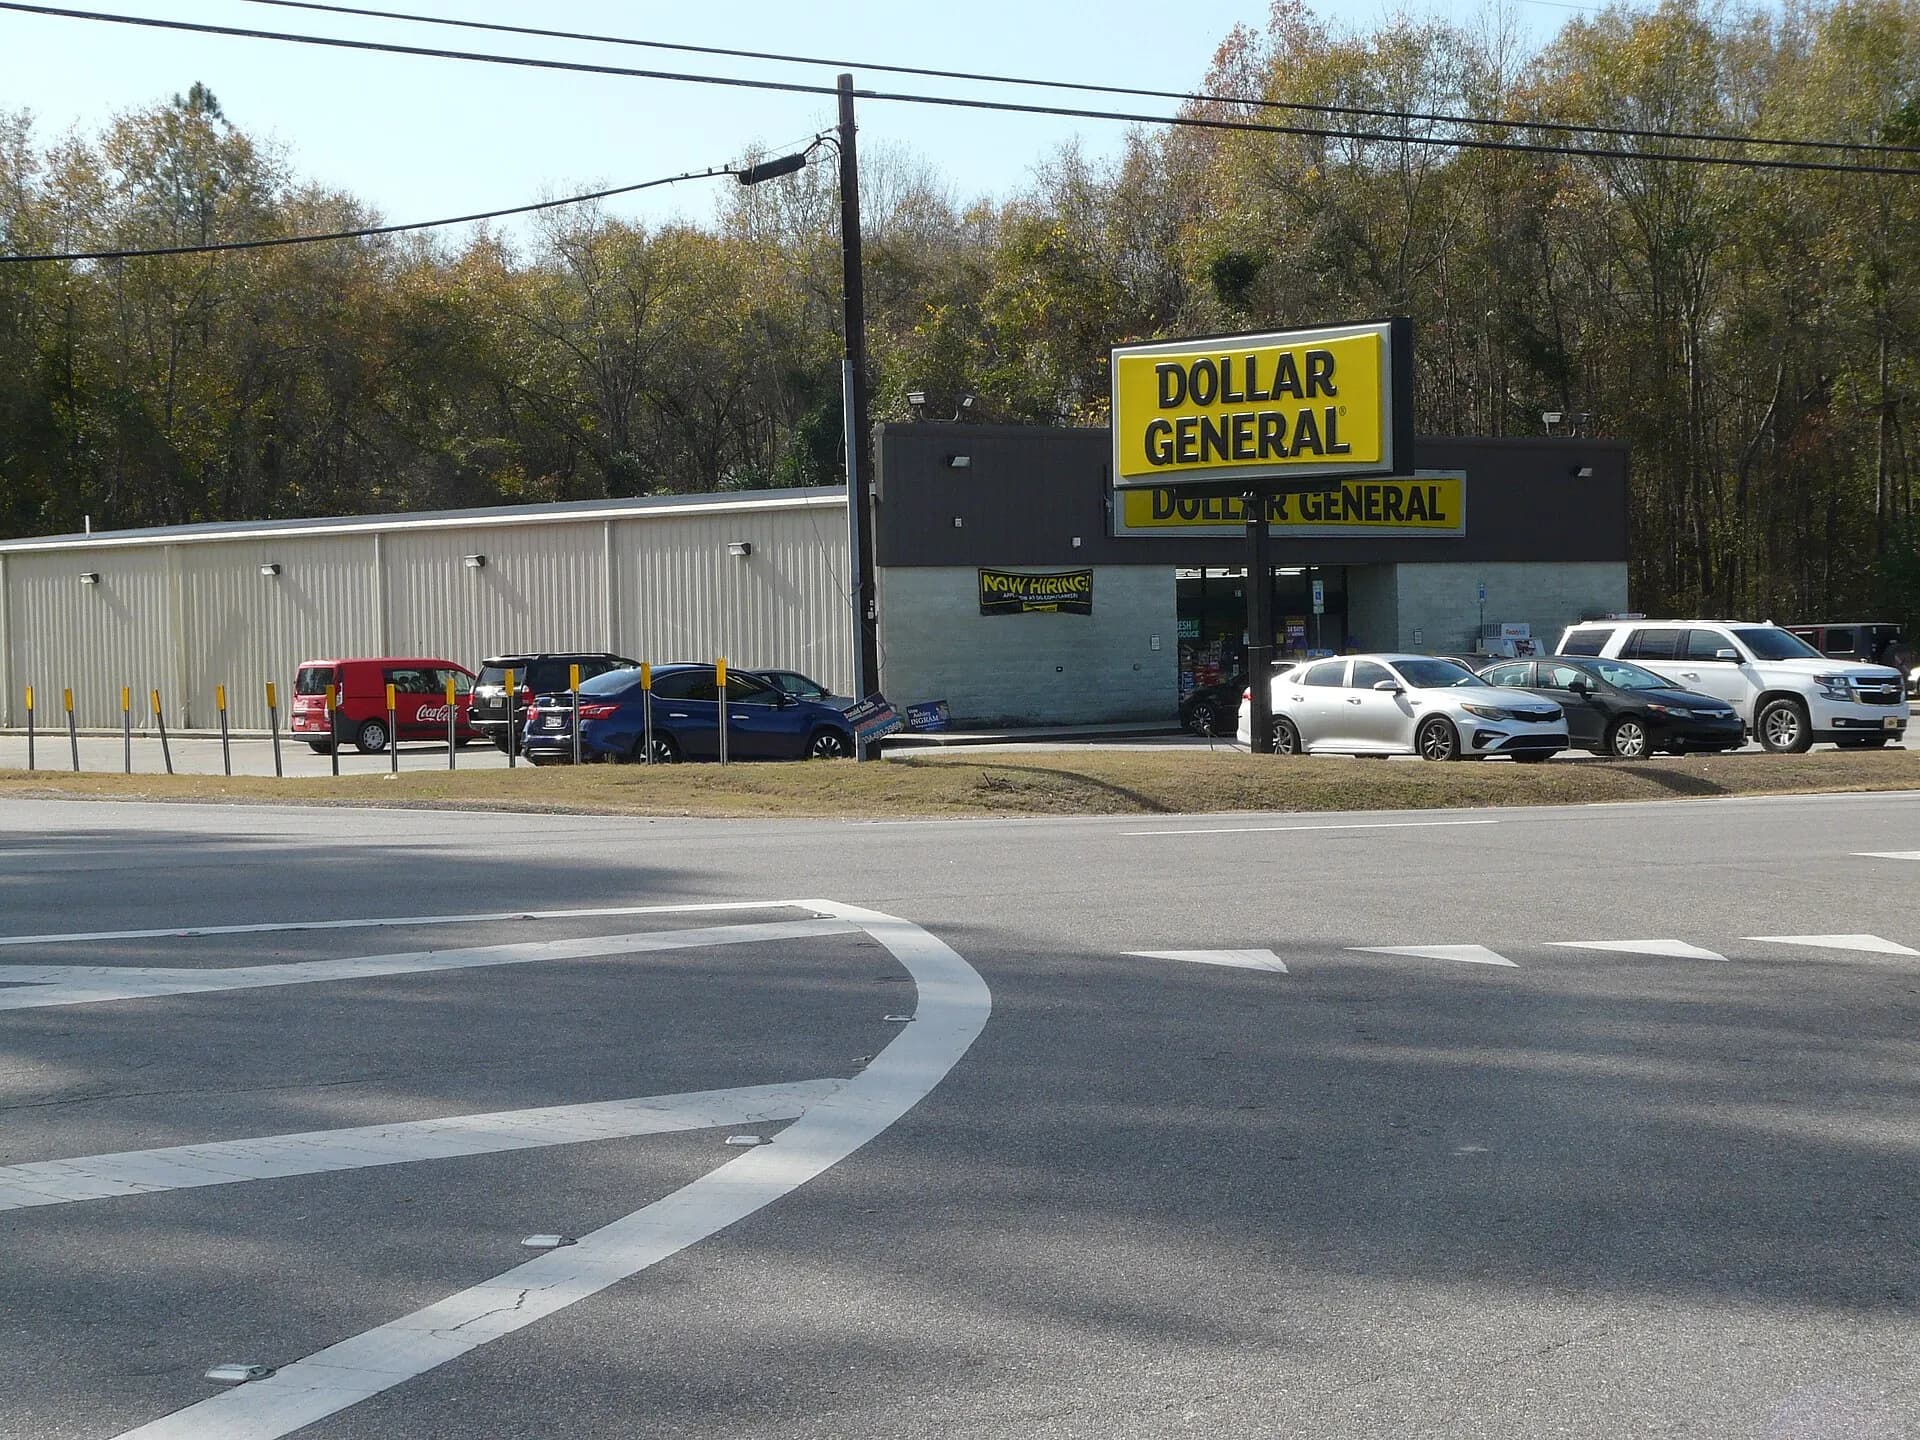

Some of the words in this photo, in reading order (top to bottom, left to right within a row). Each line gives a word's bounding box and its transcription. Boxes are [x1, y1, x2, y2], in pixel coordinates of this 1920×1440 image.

[1155, 349, 1337, 409] DOLLAR
[1144, 406, 1351, 466] GENERAL
[1152, 488, 1289, 521] DOLLR
[1299, 485, 1446, 522] GENERAL
[983, 574, 1028, 594] NOW
[1029, 575, 1090, 594] HIRING!
[416, 704, 460, 722] Coca-Co
[910, 715, 939, 726] INGRAM
